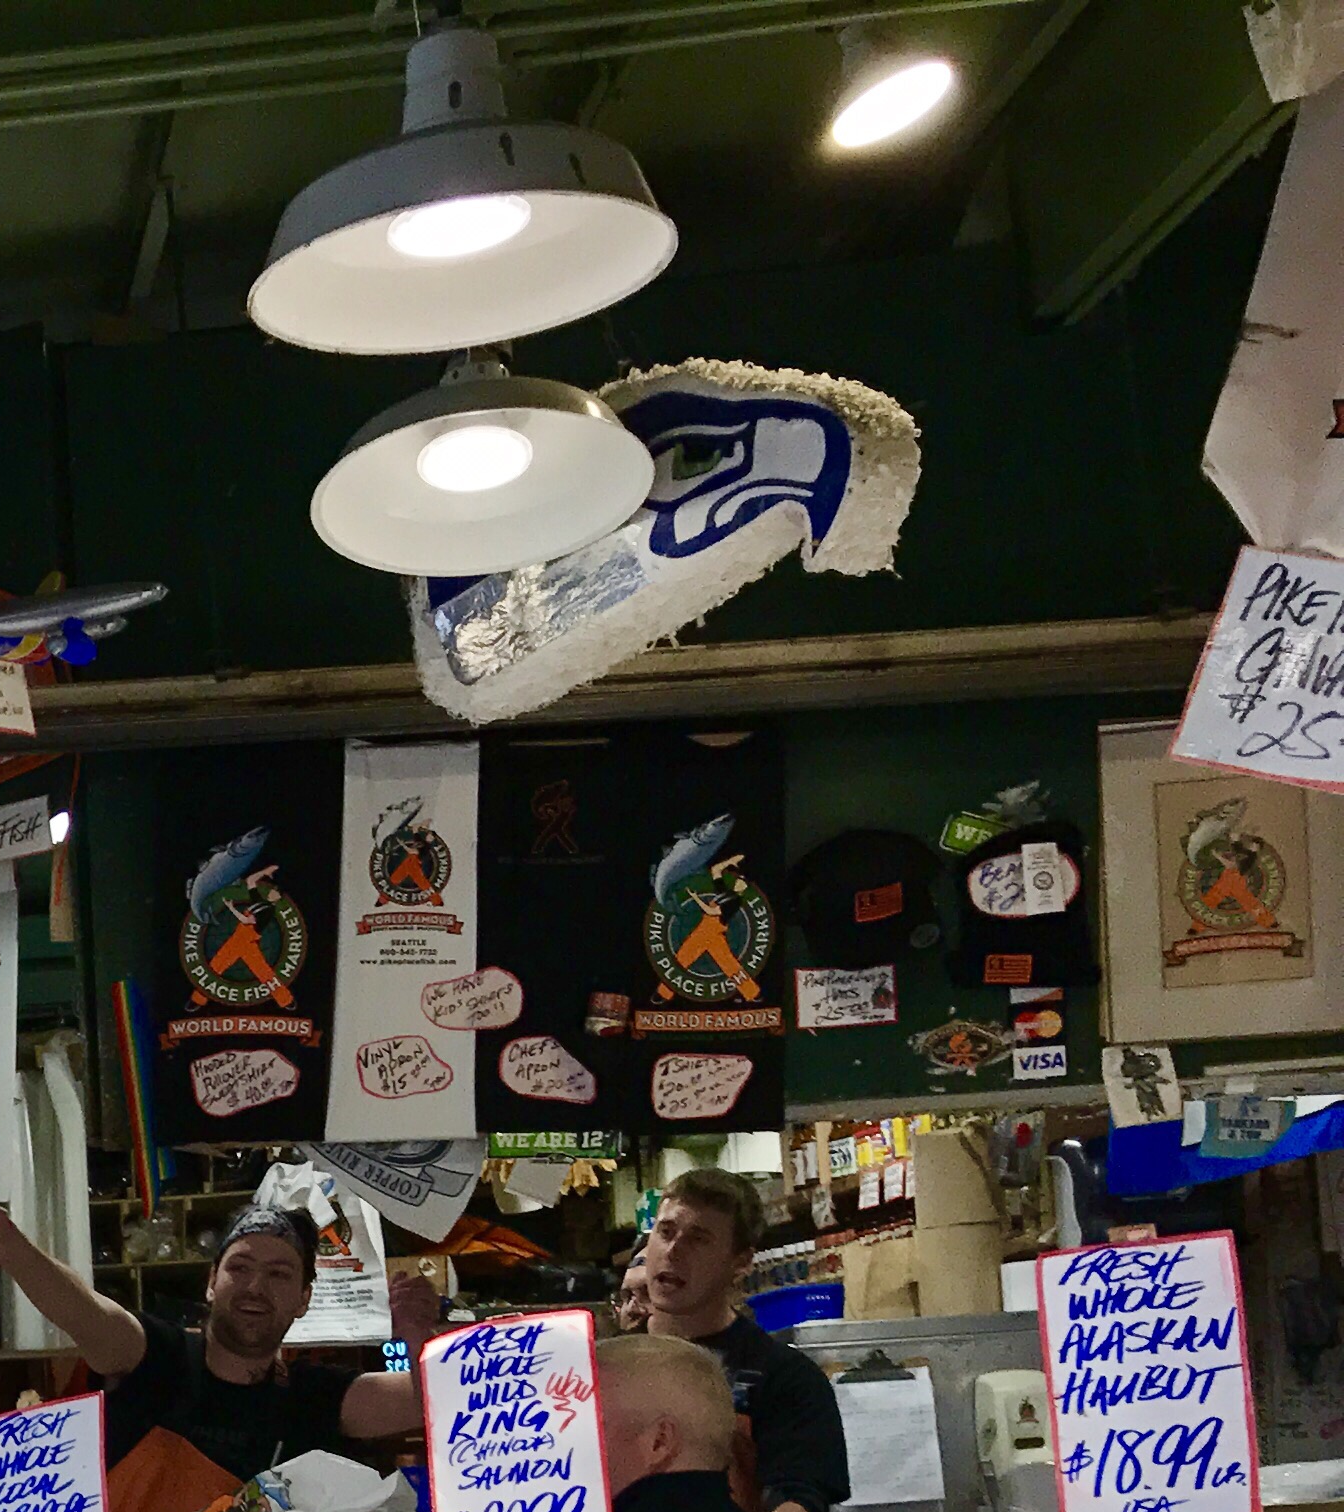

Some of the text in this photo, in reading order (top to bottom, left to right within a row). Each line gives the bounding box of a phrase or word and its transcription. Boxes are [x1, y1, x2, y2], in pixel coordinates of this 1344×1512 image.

[1239, 563, 1339, 627] PIKE
[184, 904, 303, 1002] PIKE PLACE FISH MARKET
[650, 895, 767, 997] PIKE PLACE FISH MARKET
[172, 1018, 310, 1035] WORLD FAMOUS
[639, 1010, 779, 1031] WORLD FAMOUS
[515, 1059, 561, 1080] APRON
[1019, 1052, 1064, 1071] VISA
[496, 1131, 526, 1150] WE
[527, 1131, 579, 1149] ARE
[322, 1141, 422, 1200] COPPER RIVE
[1059, 1245, 1195, 1286] FRESH
[1069, 1280, 1206, 1320] WHOLE
[440, 1323, 554, 1363] FRESH
[1059, 1307, 1238, 1370] ALASKAN
[460, 1351, 553, 1386] WHOLE
[469, 1378, 538, 1412] WILD
[1055, 1363, 1243, 1416] HALIBUT
[447, 1400, 550, 1444] KING
[449, 1431, 555, 1467] (CHINOOK)
[459, 1448, 575, 1491] SALMON
